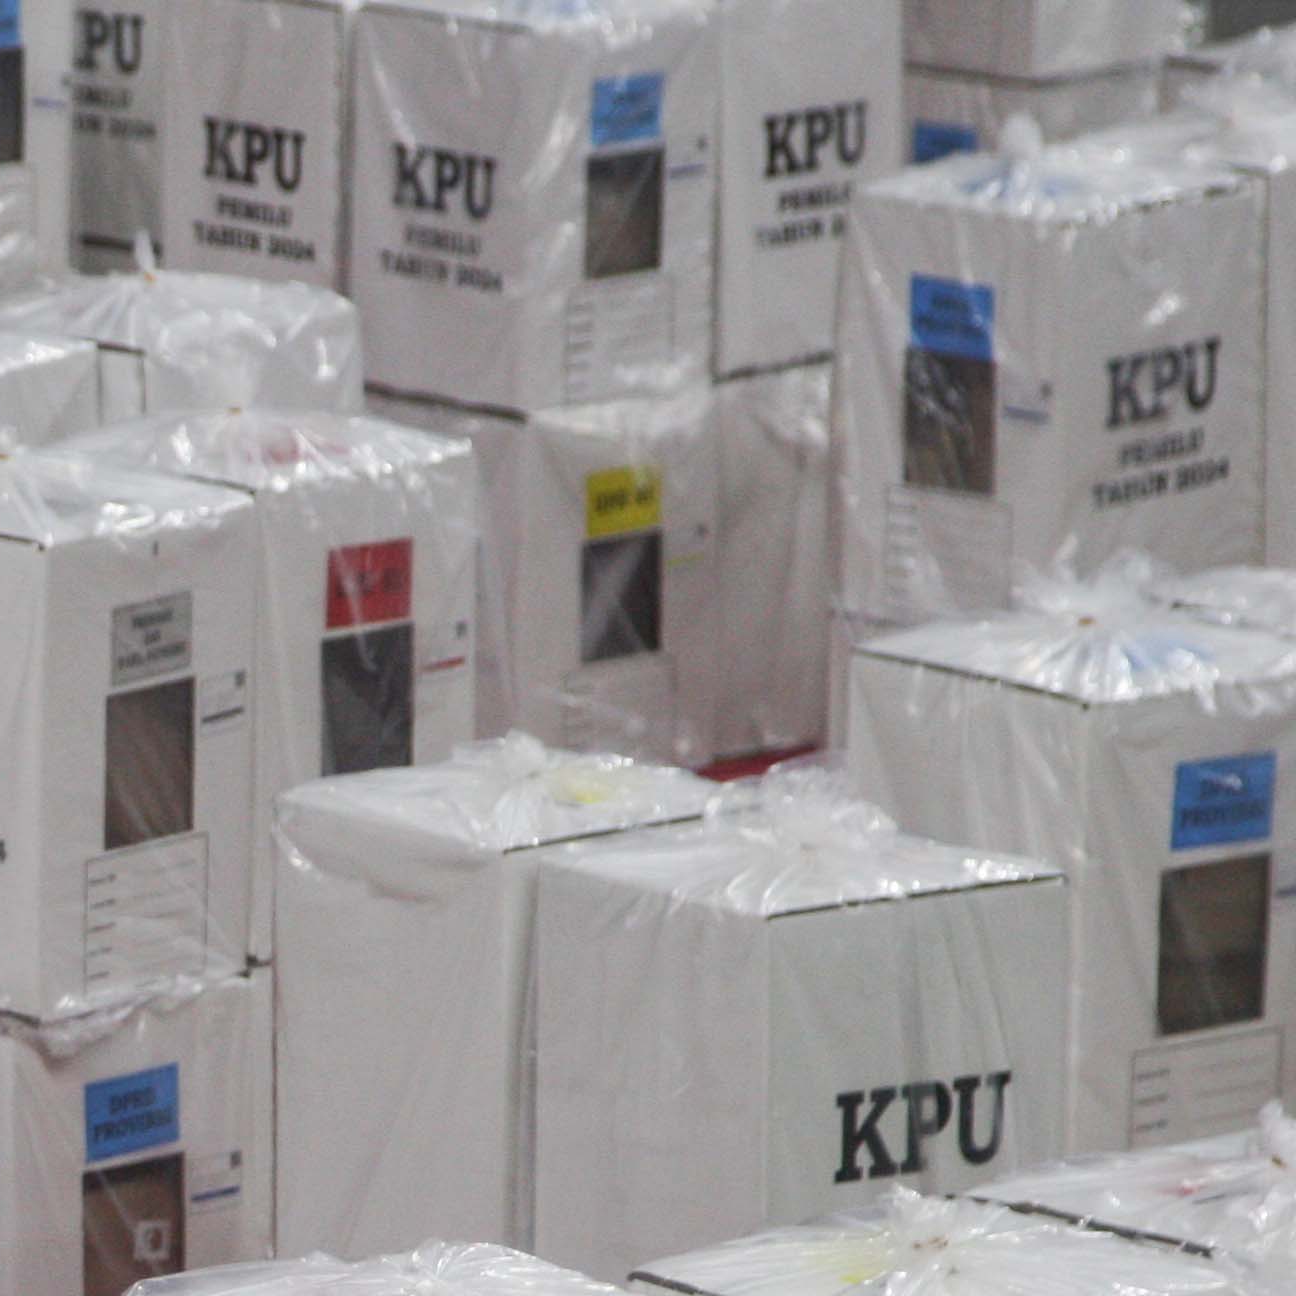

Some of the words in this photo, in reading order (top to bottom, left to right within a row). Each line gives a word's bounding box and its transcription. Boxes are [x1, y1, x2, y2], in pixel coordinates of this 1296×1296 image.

[74, 10, 143, 74] PU
[203, 115, 305, 193] KPU
[764, 99, 868, 180] KPU
[392, 141, 497, 220] KPU
[1106, 335, 1221, 431] KPU
[834, 1070, 1013, 1184] KPU
